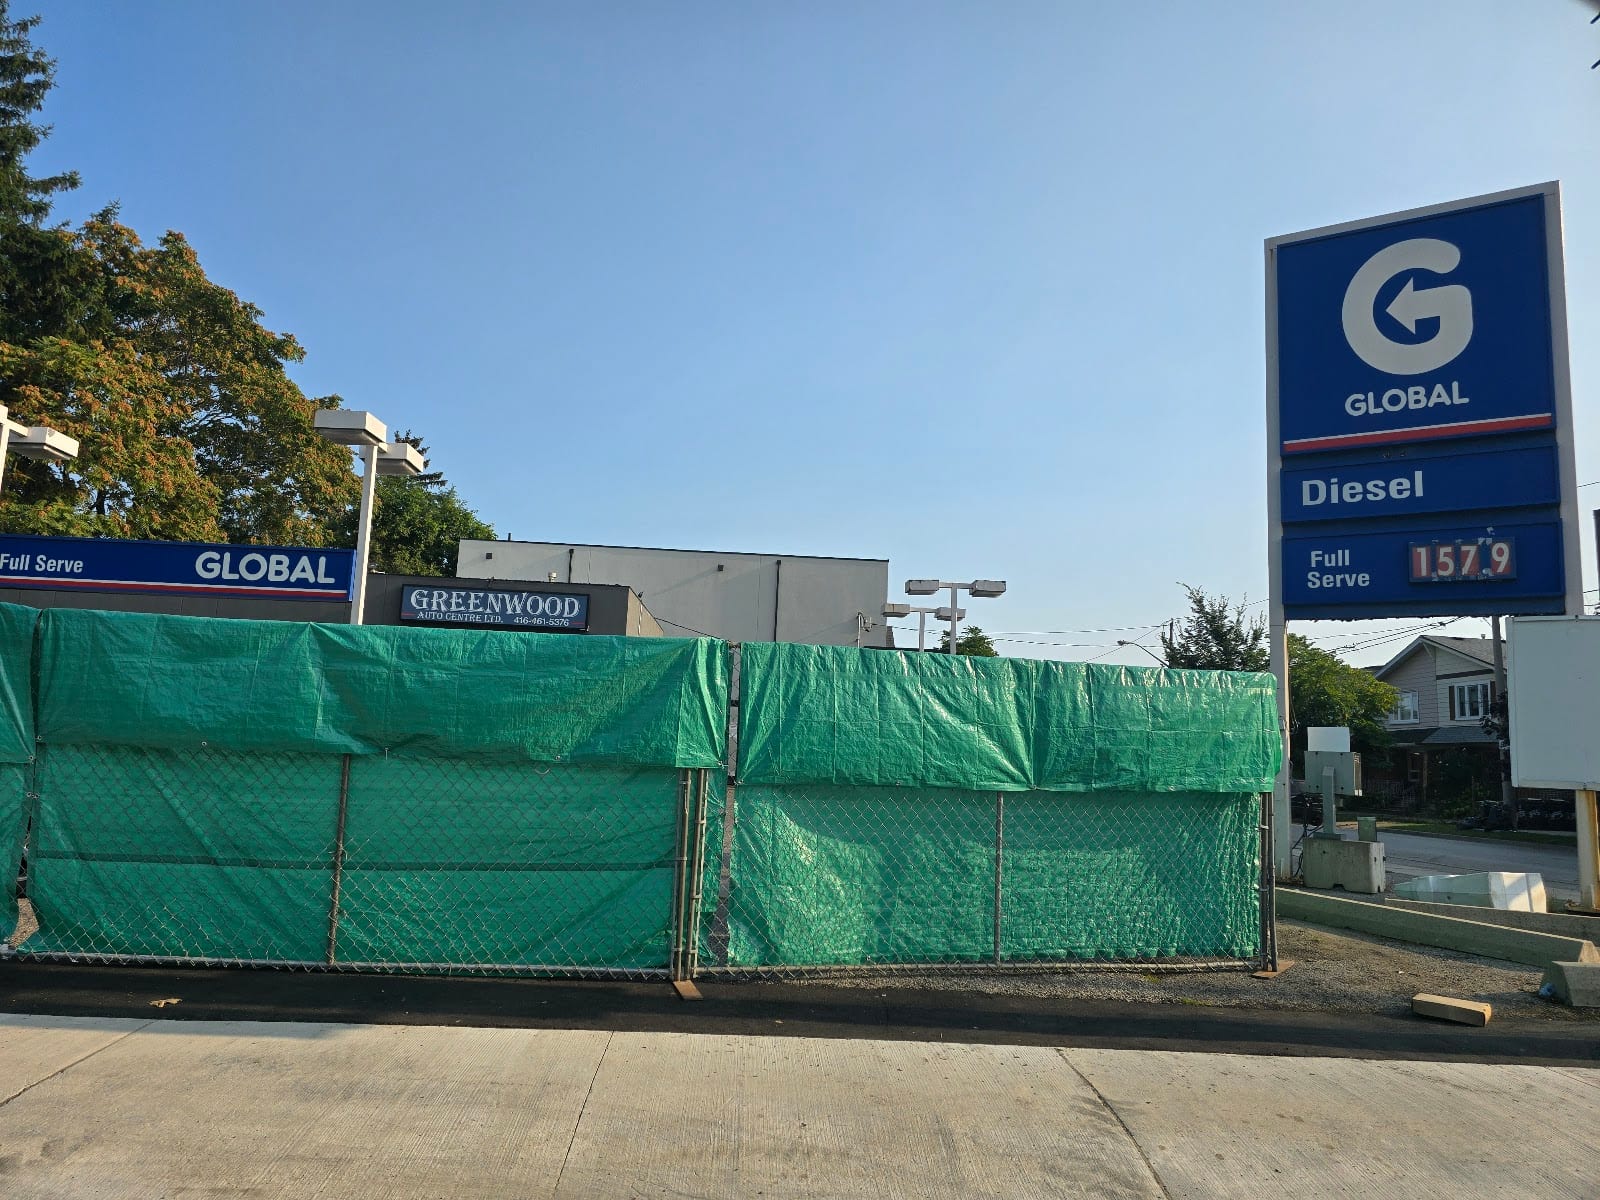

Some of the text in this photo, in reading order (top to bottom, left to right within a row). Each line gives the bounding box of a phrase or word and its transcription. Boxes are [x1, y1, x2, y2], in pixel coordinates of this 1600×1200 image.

[1344, 381, 1469, 417] GLOBAL
[1302, 470, 1424, 507] Diesel
[0, 553, 84, 573] Full Serve
[195, 551, 336, 584] GLOBAL
[1310, 549, 1350, 568] Full
[1307, 571, 1370, 589] Serve
[410, 589, 581, 618] GREENWOOD
[416, 611, 569, 627] AUTO CENTRE LTD. 416-461-5376
